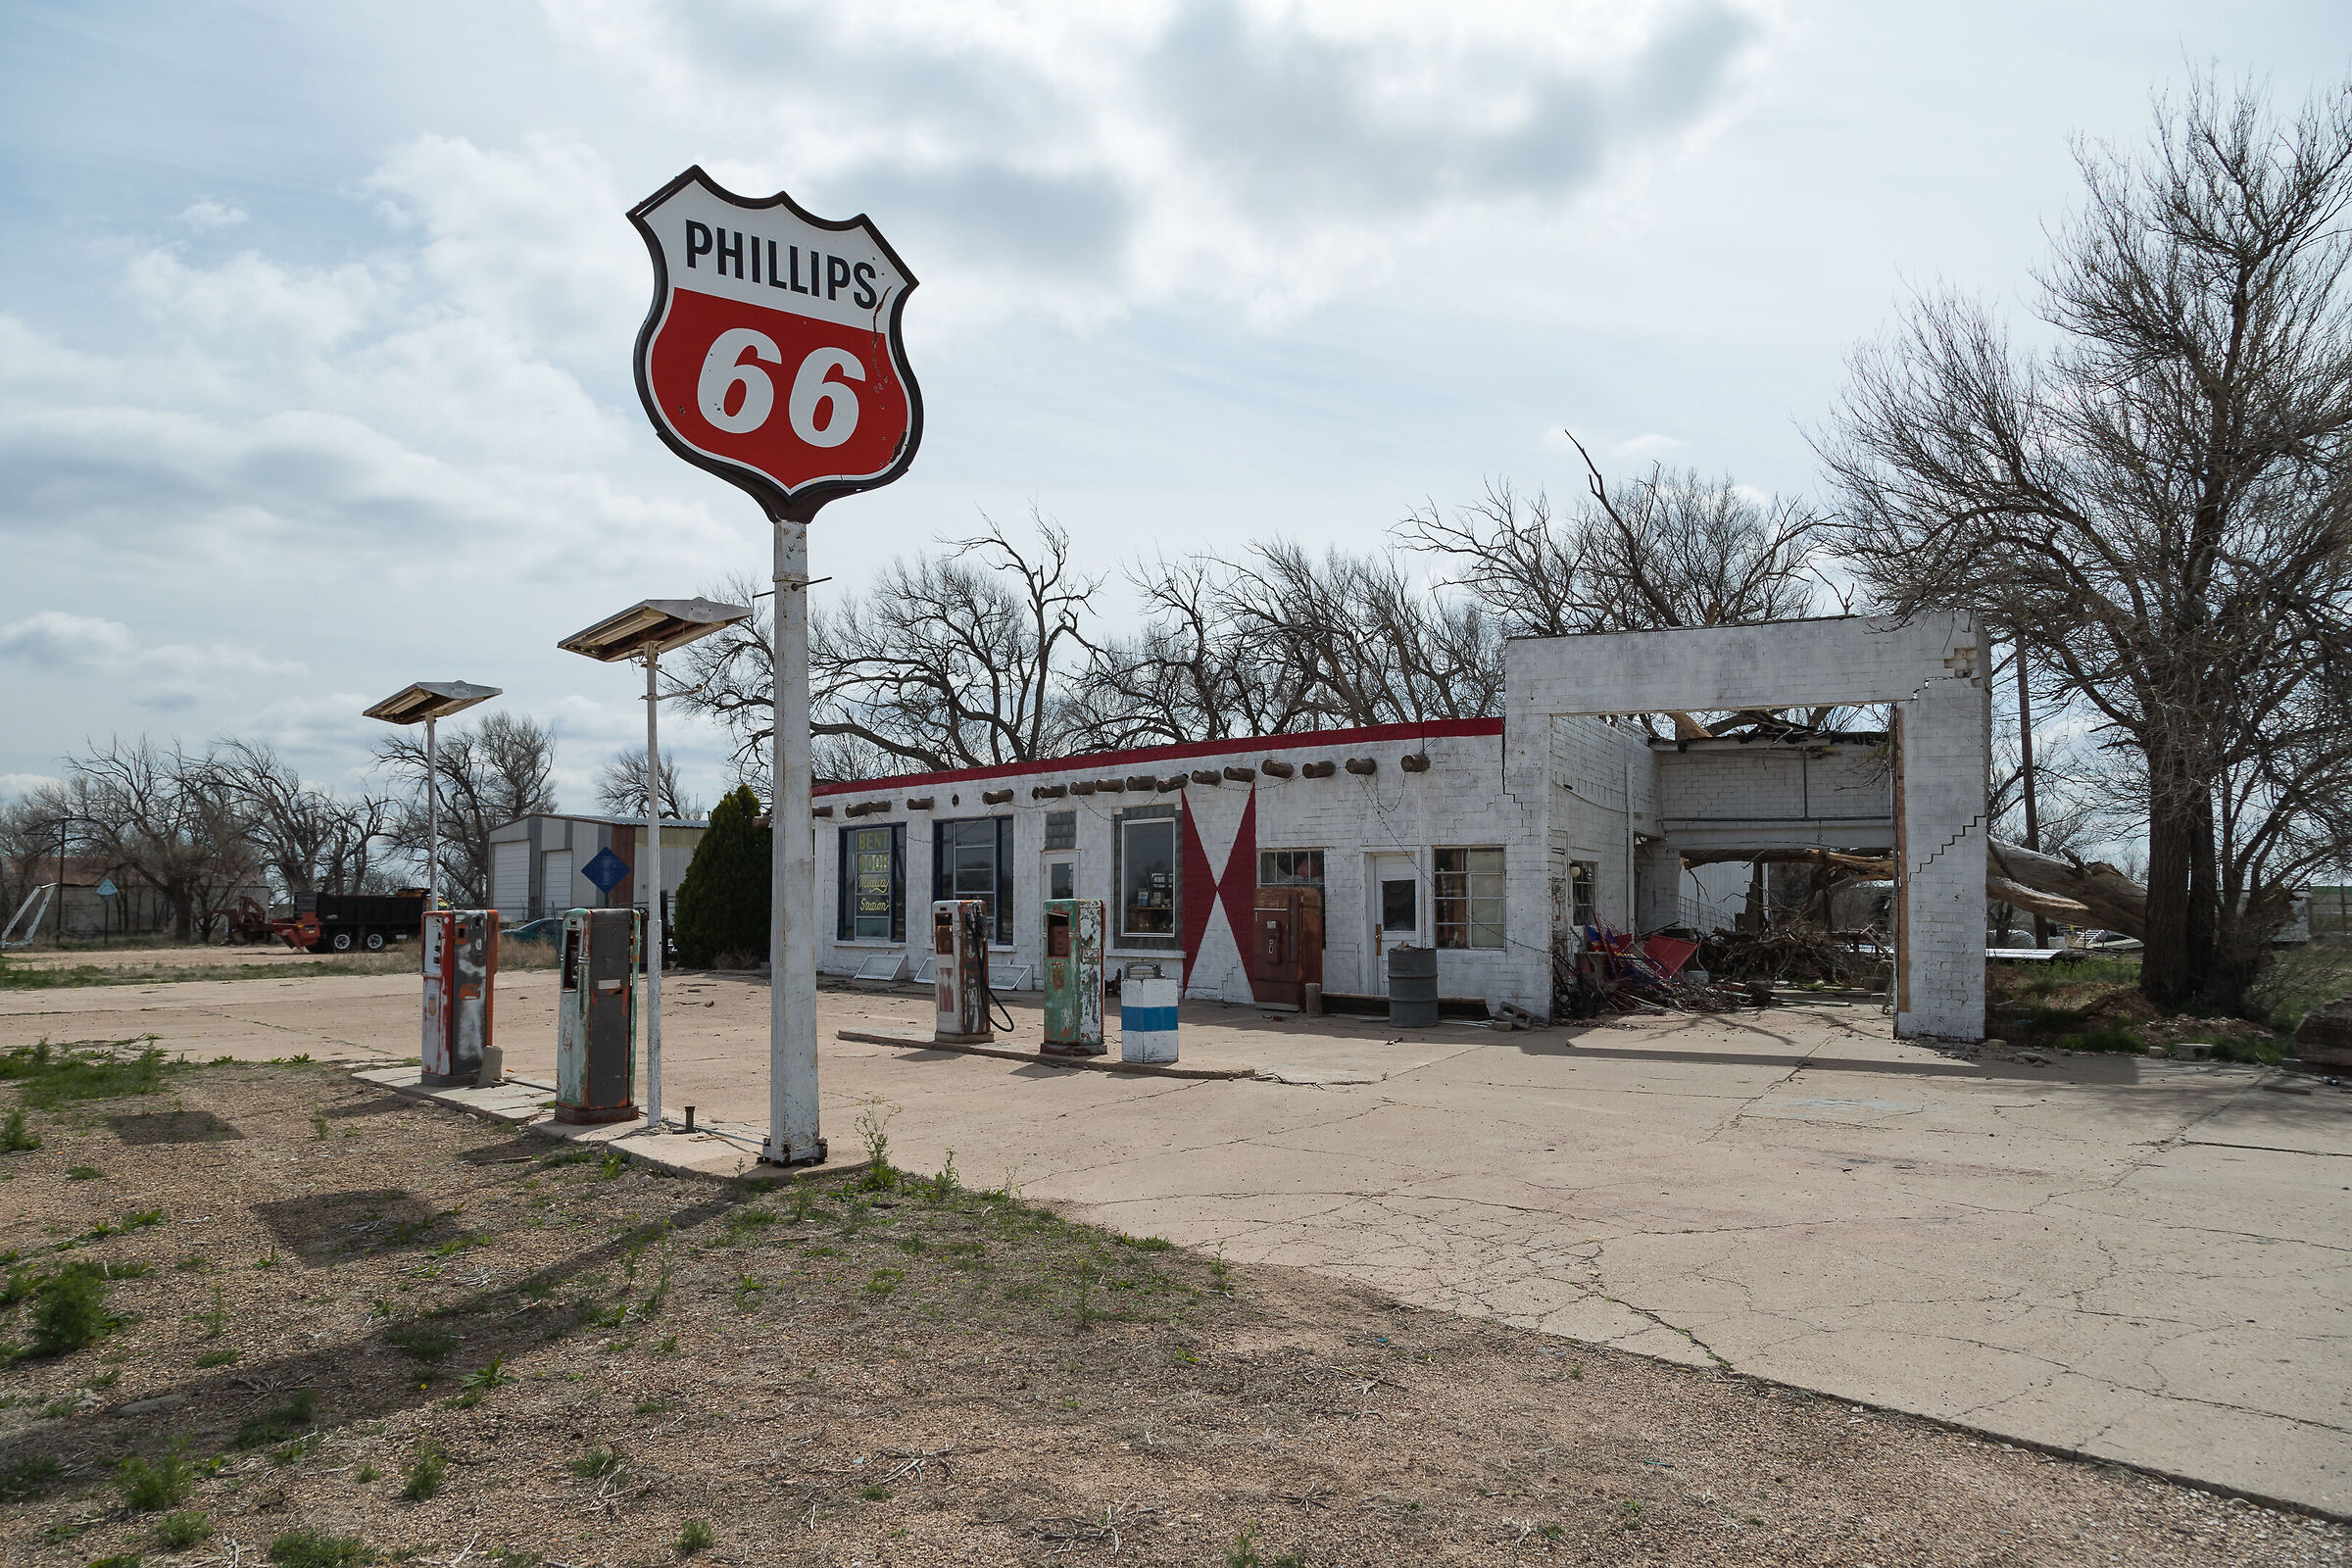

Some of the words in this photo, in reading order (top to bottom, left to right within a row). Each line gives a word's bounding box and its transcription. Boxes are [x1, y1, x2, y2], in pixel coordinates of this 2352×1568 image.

[686, 220, 877, 310] PHILLIPS
[697, 327, 866, 448] 66
[858, 831, 889, 851] BENT
[858, 854, 889, 871] DOOR
[859, 898, 890, 911] Station
